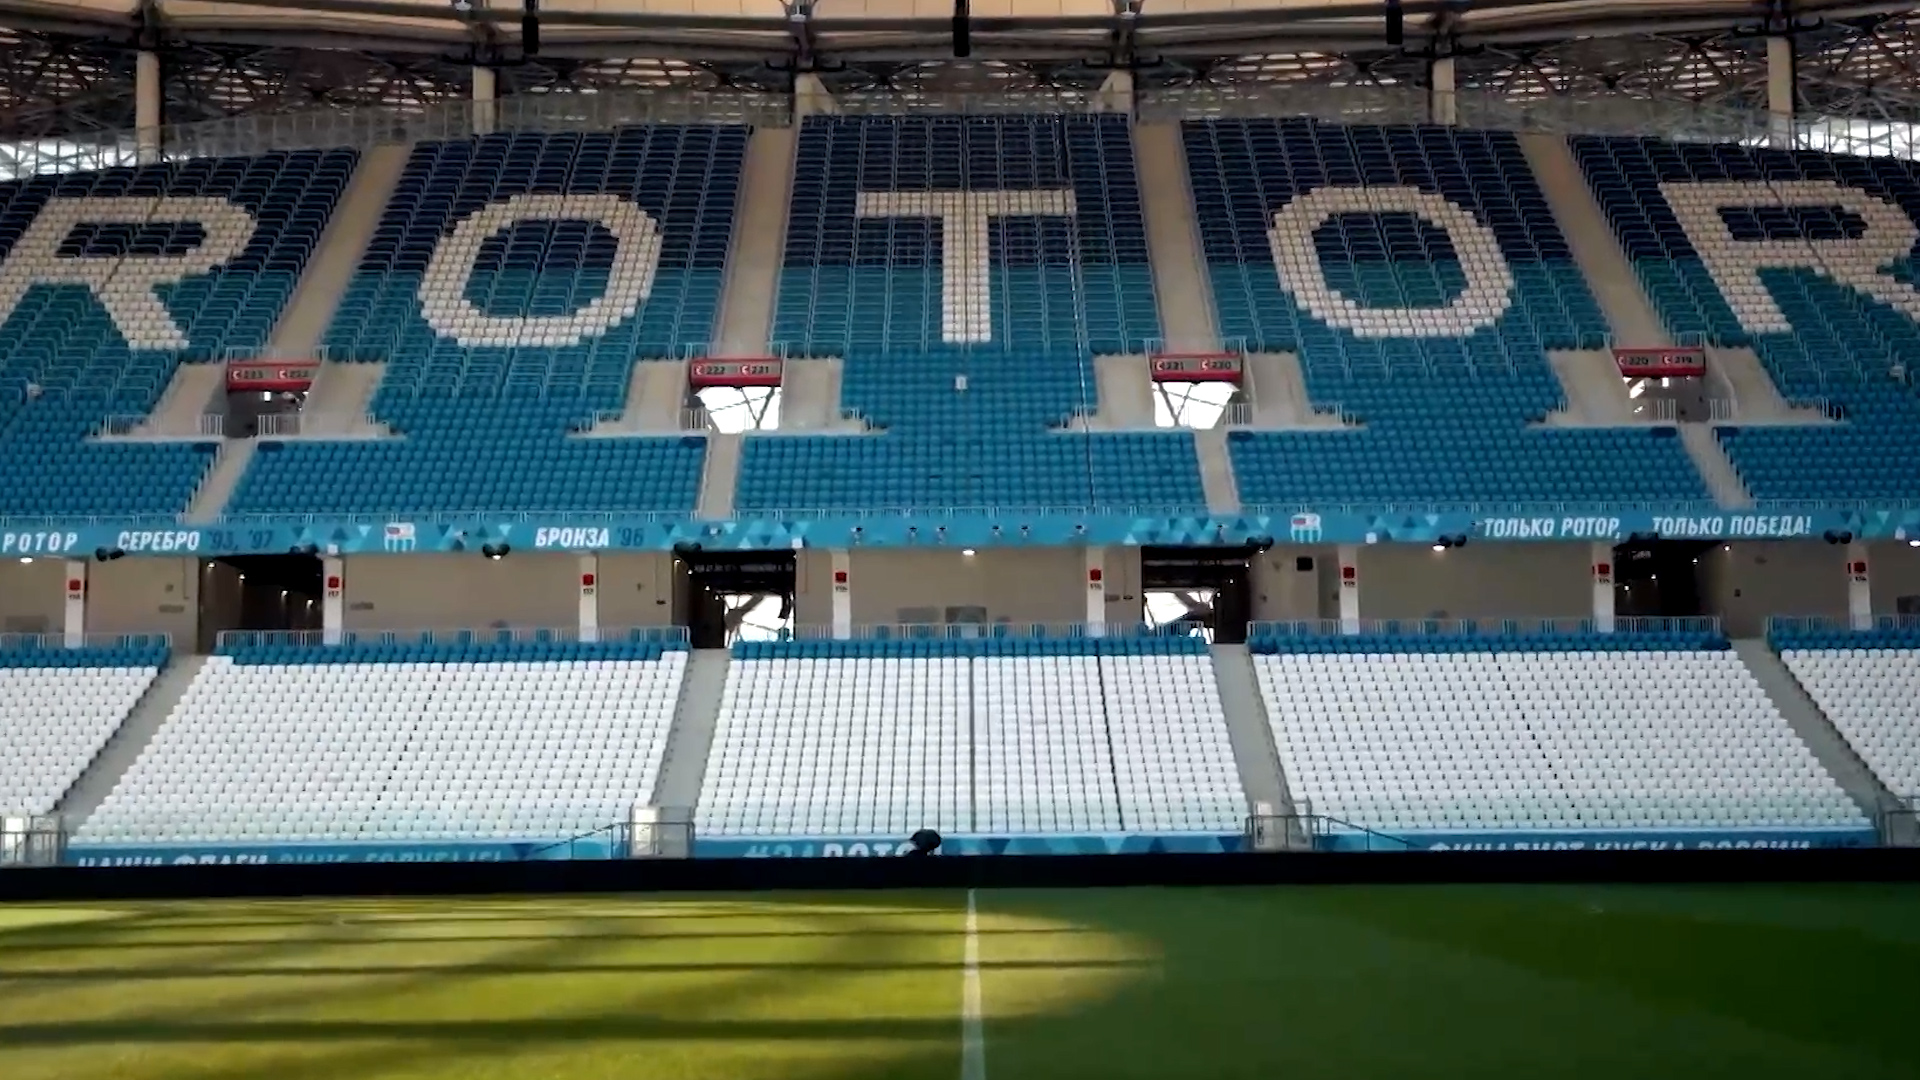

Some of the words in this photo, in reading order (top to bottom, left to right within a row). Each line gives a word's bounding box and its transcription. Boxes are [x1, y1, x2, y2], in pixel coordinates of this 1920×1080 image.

[535, 527, 610, 547] БРОНЗА
[1483, 517, 1554, 538] ТОЛЬКО
[1560, 517, 1621, 539] РОТОР,
[1652, 516, 1722, 536] ТОЛЬКО
[1729, 516, 1812, 537] ПОБЕДА!
[2, 532, 78, 552] РОТОР
[117, 530, 200, 551] СЕРЕБРО
